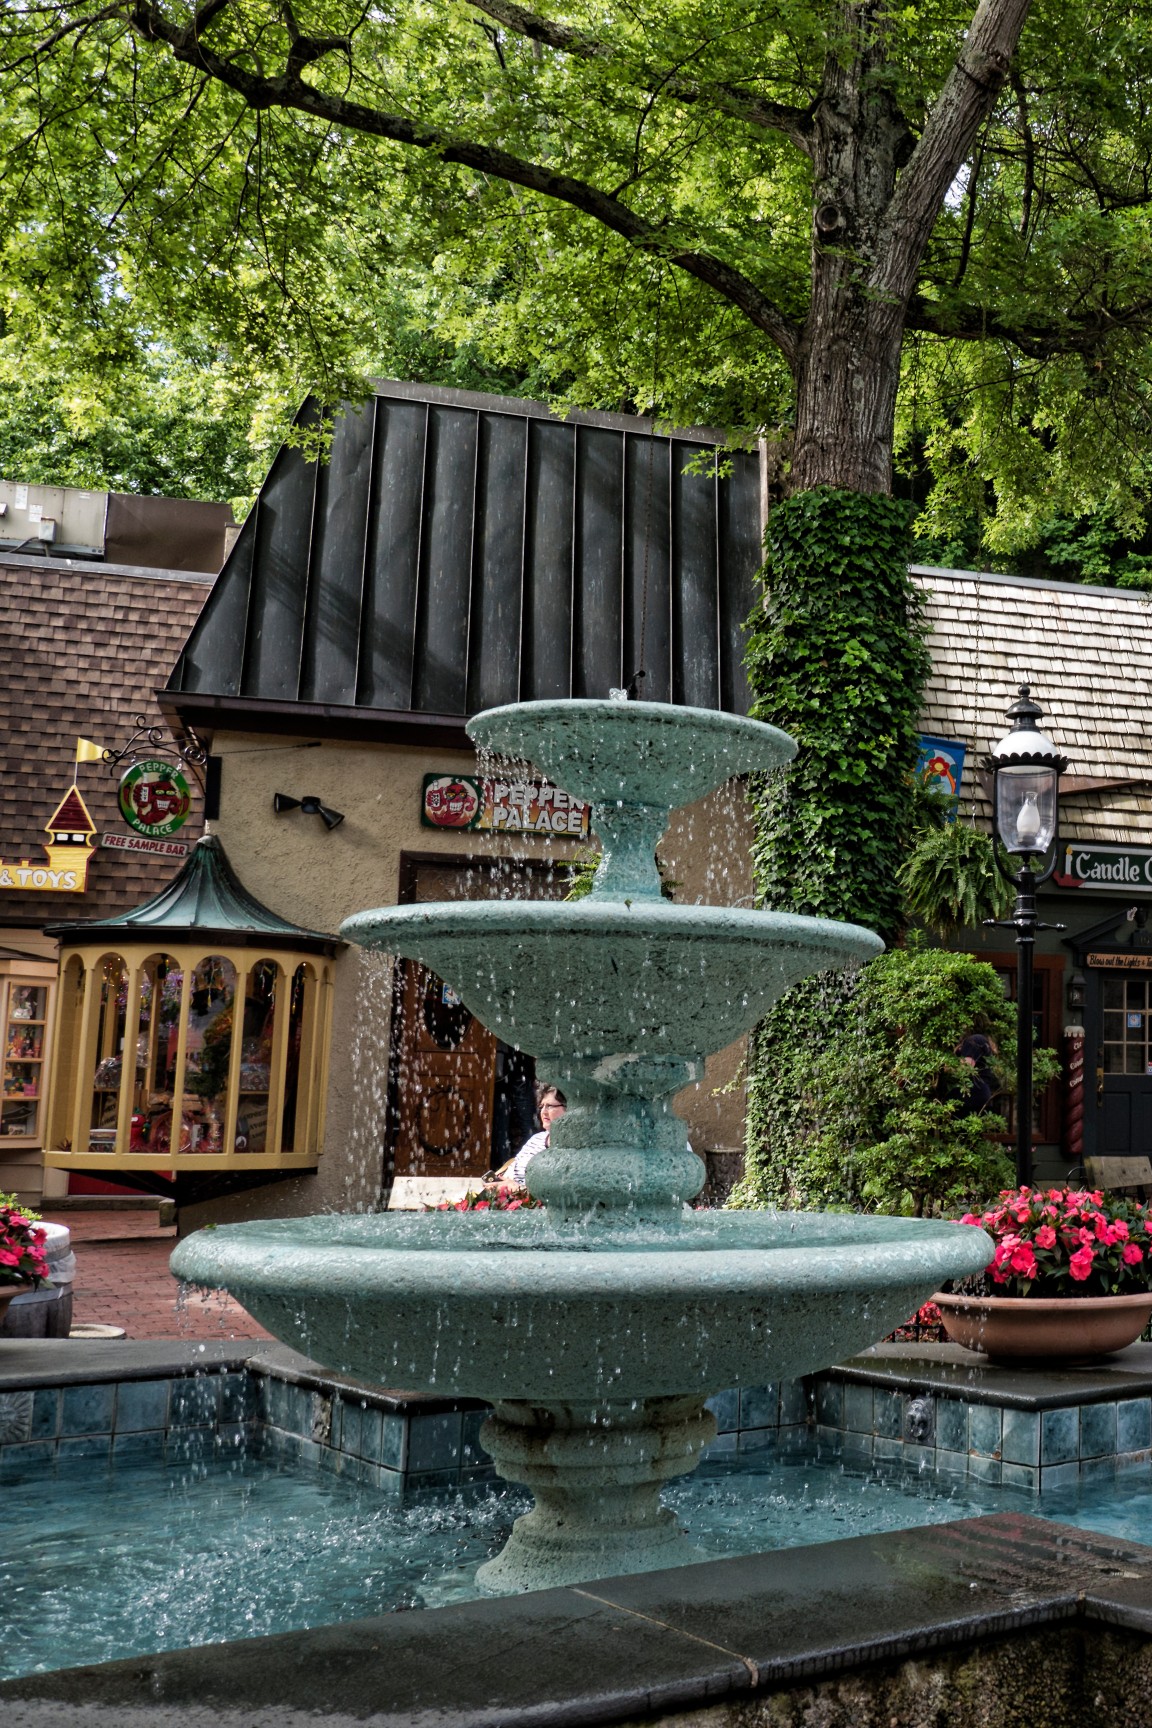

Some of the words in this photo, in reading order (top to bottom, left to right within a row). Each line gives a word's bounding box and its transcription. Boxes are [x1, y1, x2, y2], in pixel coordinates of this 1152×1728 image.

[138, 762, 179, 780] PEPPER
[132, 819, 173, 835] PALACE
[492, 806, 583, 833] PALACE
[104, 835, 127, 847] FREE
[127, 838, 164, 853] SAMPLE
[165, 845, 185, 856] BAR
[1076, 853, 1139, 881] Candle
[0, 868, 15, 886] &
[16, 868, 77, 889] TOYS
[1090, 955, 1104, 965] Blow
[1116, 956, 1124, 966] the
[1124, 956, 1140, 968] Lights
